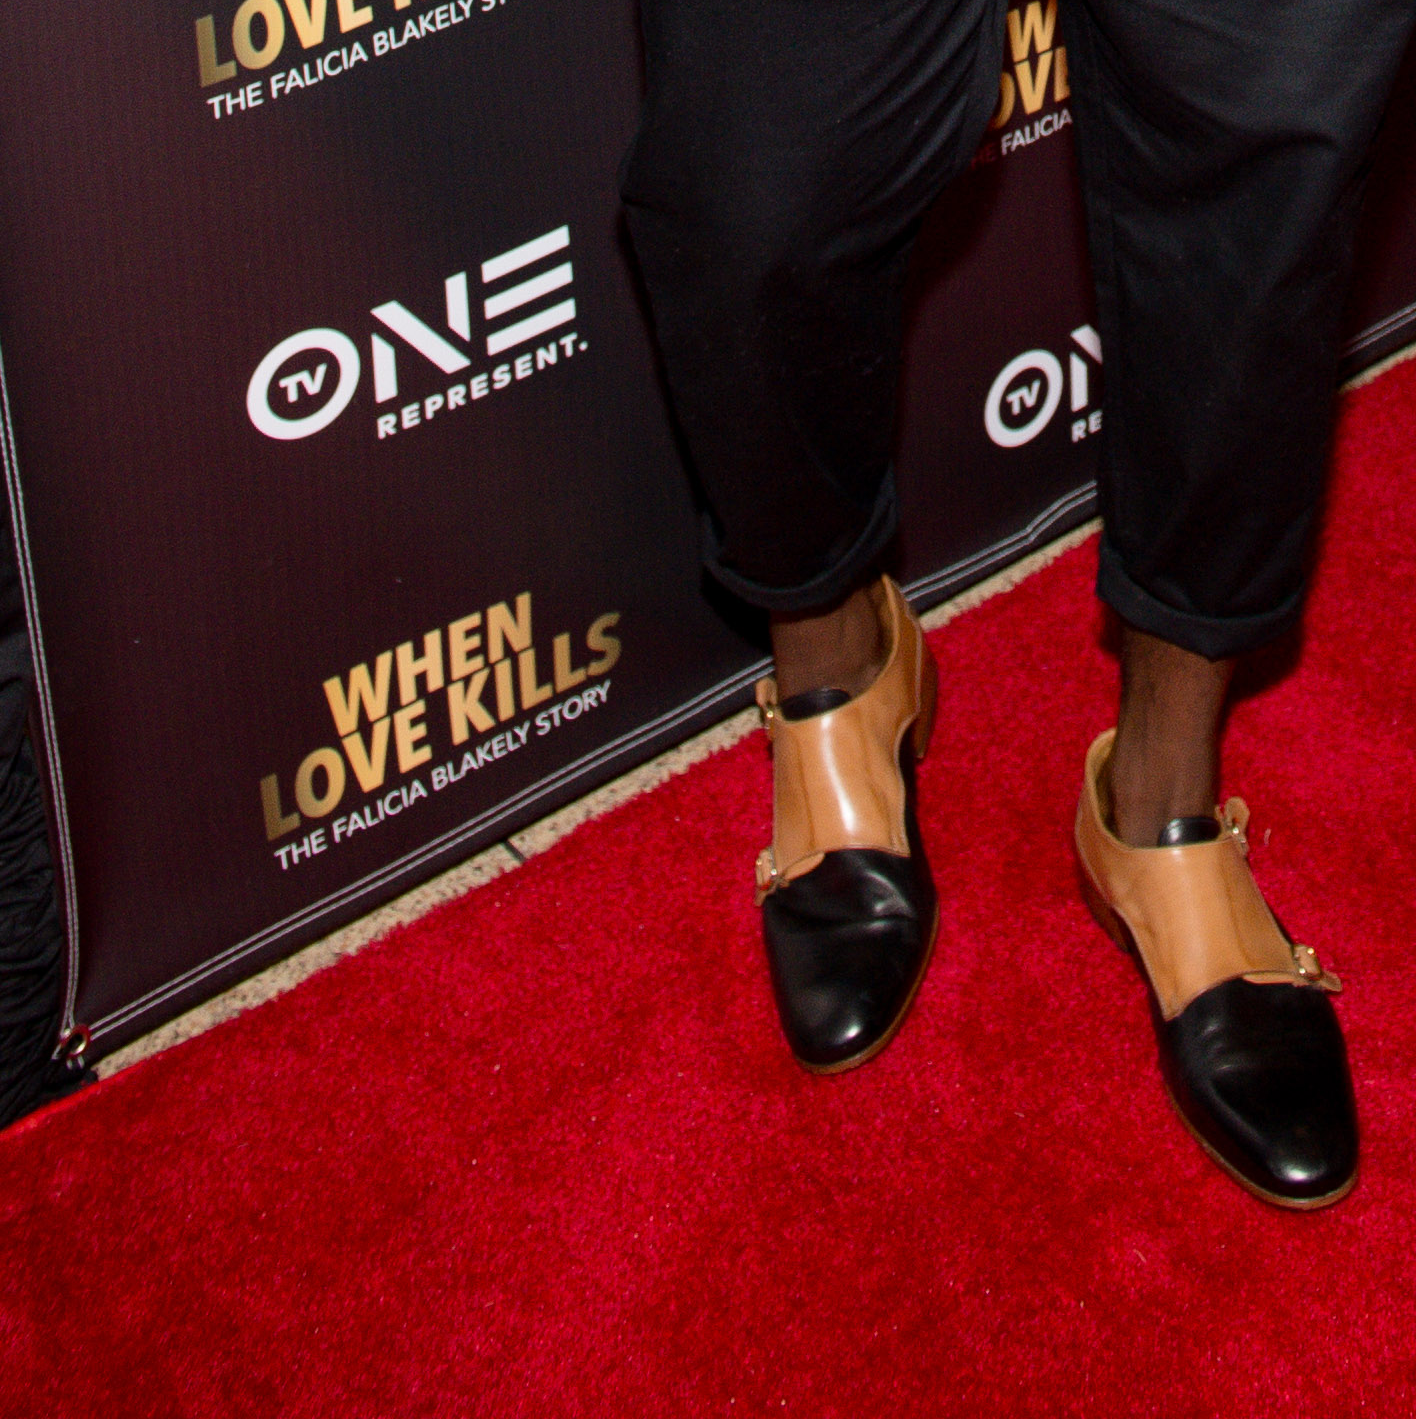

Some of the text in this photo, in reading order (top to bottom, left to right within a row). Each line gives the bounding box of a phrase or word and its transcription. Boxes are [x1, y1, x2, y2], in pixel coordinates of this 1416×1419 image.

[209, 81, 263, 119] THE
[269, 42, 367, 97] FALICIA
[1000, 108, 1074, 155] FALICIA
[248, 228, 575, 442] ONE
[280, 363, 326, 403] TV
[378, 334, 587, 439] REPRESENT.
[1006, 379, 1040, 416] TV
[322, 586, 530, 738] WHEN
[260, 608, 619, 841] LOVE KILLS
[273, 681, 610, 868] THE FALICIA BLAKELY STORY
